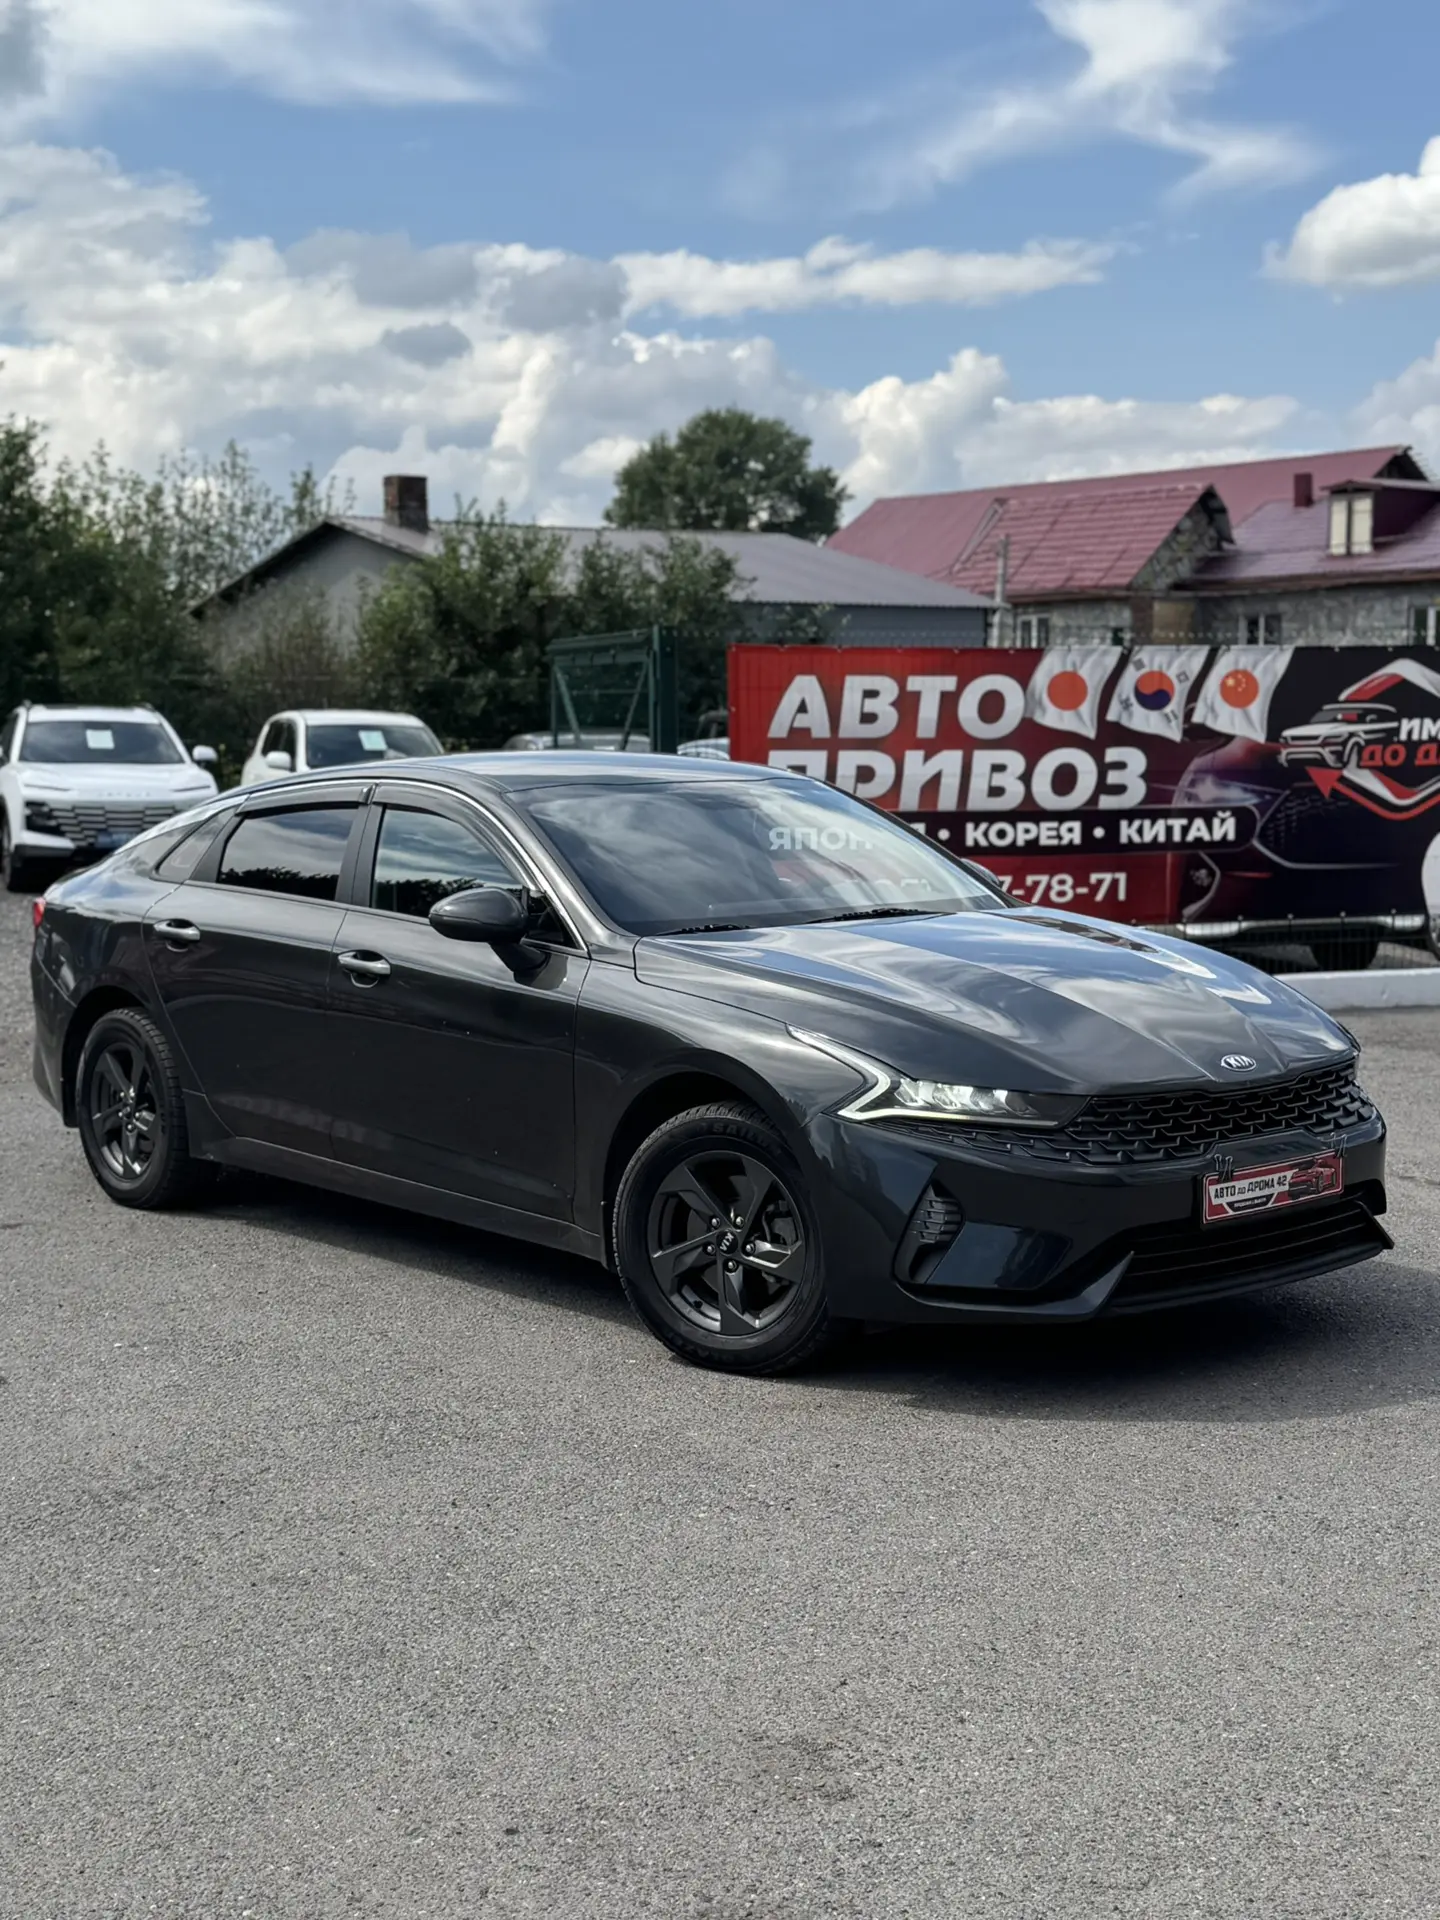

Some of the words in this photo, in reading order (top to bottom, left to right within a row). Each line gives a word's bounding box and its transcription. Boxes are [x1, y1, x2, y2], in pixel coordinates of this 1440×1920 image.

[767, 672, 1026, 740] АВТО
[1359, 743, 1408, 768] ДО
[965, 820, 1082, 848] КОРЕЯ
[1119, 811, 1237, 843] КИТАЙ
[1226, 1056, 1253, 1068] KIA
[1214, 1184, 1236, 1199] АВТО
[1247, 1178, 1275, 1194] ДРОМА
[1276, 1174, 1288, 1187] 42
[719, 1232, 734, 1251] KIA
